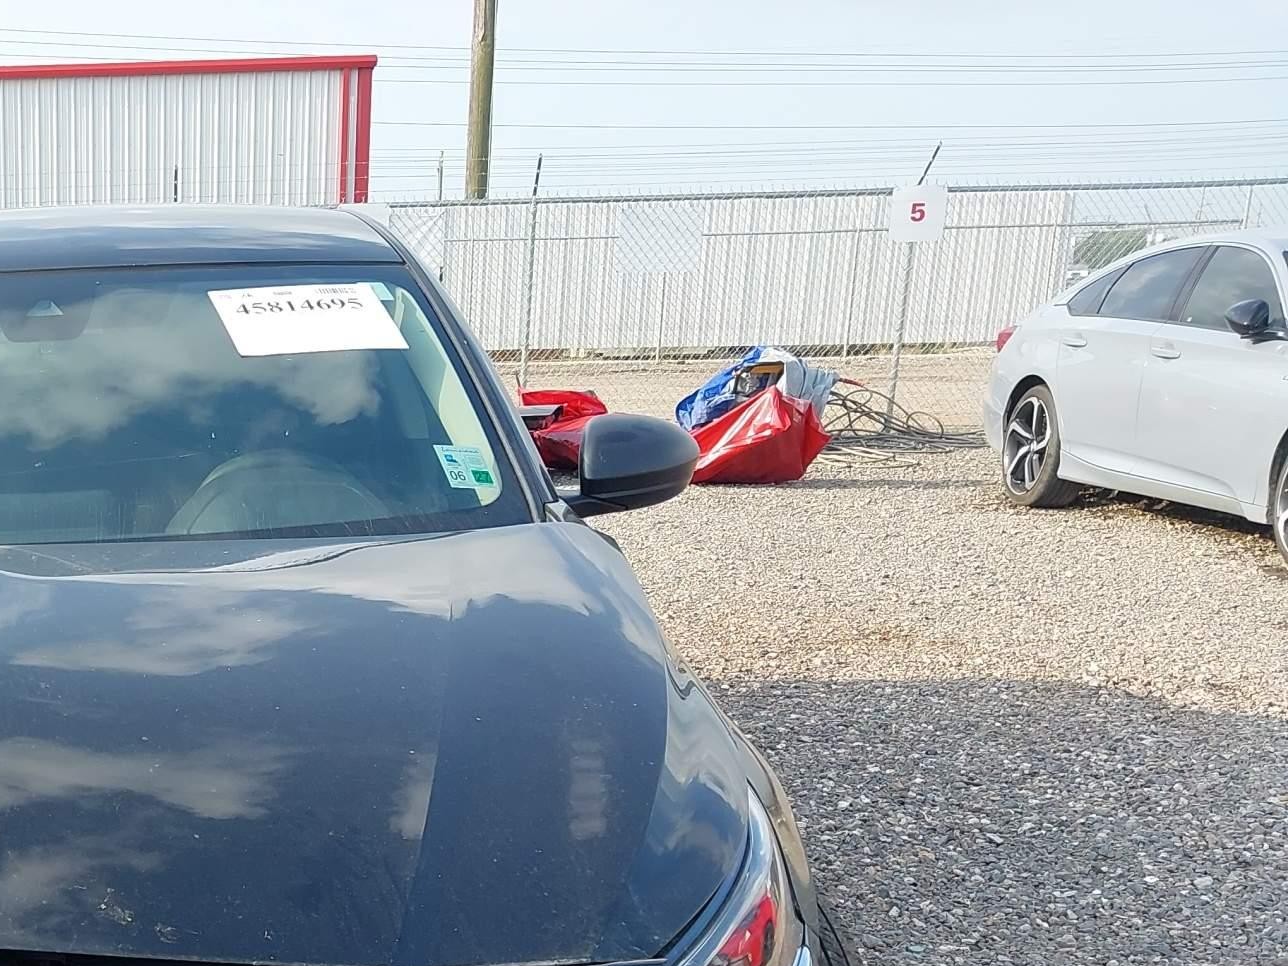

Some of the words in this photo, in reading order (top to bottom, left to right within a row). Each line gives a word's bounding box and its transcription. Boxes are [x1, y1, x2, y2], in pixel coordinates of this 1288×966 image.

[910, 202, 926, 222] 5
[235, 297, 364, 315] 45814695
[449, 470, 467, 481] 06
